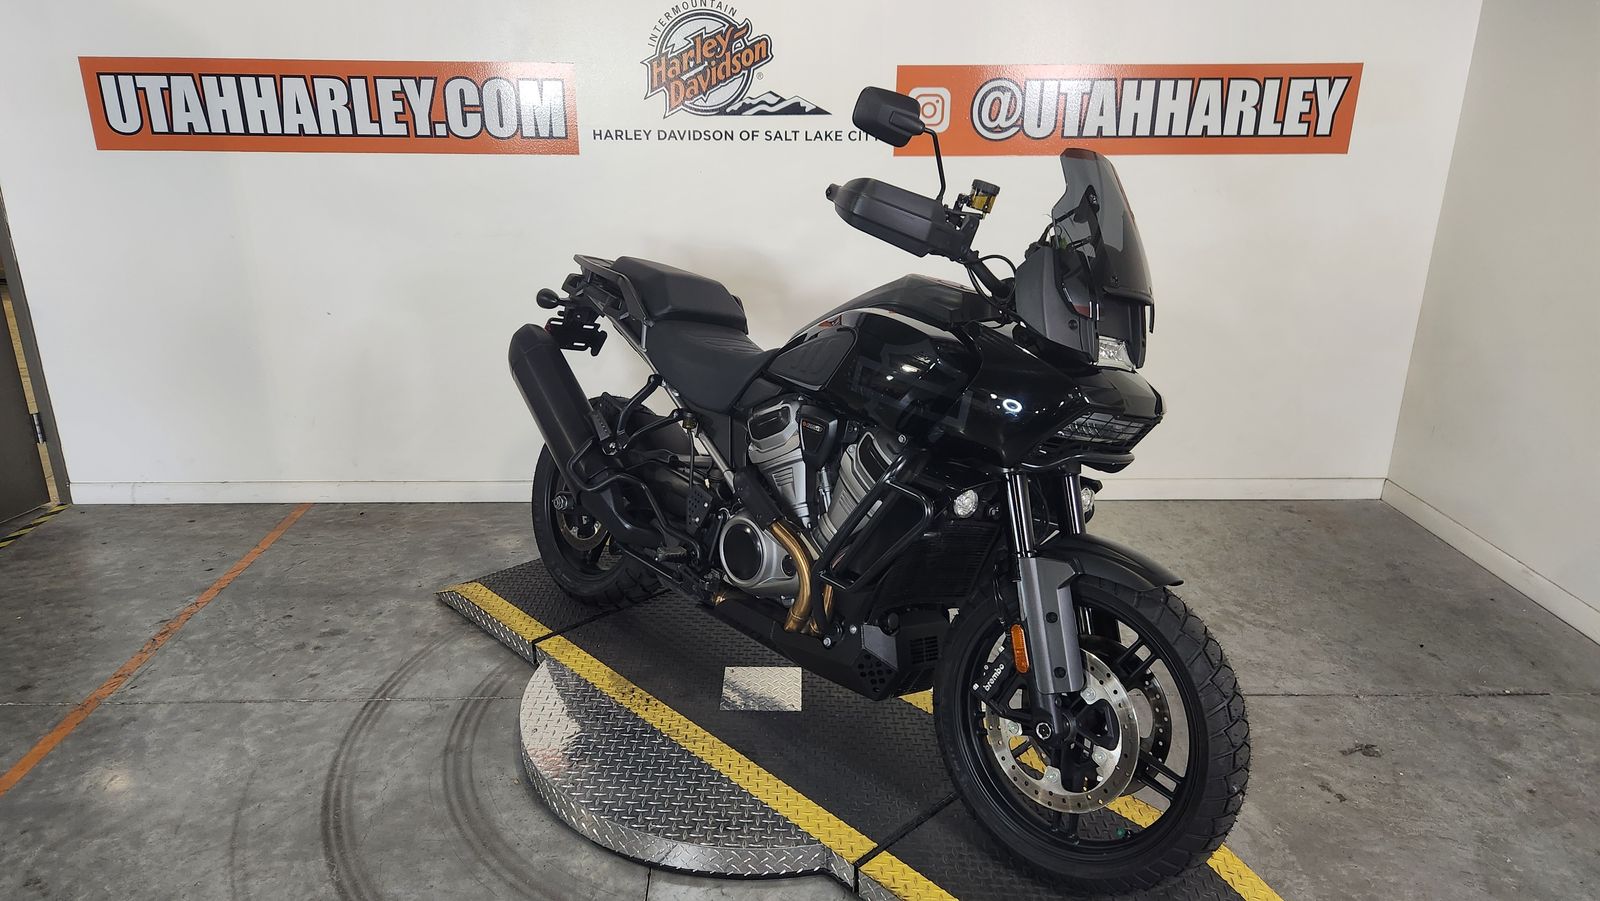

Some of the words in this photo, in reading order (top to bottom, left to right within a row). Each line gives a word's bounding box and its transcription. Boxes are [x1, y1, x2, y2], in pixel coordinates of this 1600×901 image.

[648, 0, 738, 48] INTERMOUNTAIN
[669, 39, 768, 109] Davidson
[97, 72, 567, 139] UTAHHARLEY.COM
[970, 76, 1352, 141] @UTAHHARLEY
[592, 129, 652, 141] HARLEY
[658, 130, 733, 142] DAVIDSON
[739, 130, 759, 142] OF
[764, 130, 800, 142] SALT
[805, 130, 844, 142] LAKE
[983, 663, 1005, 691] brembo
